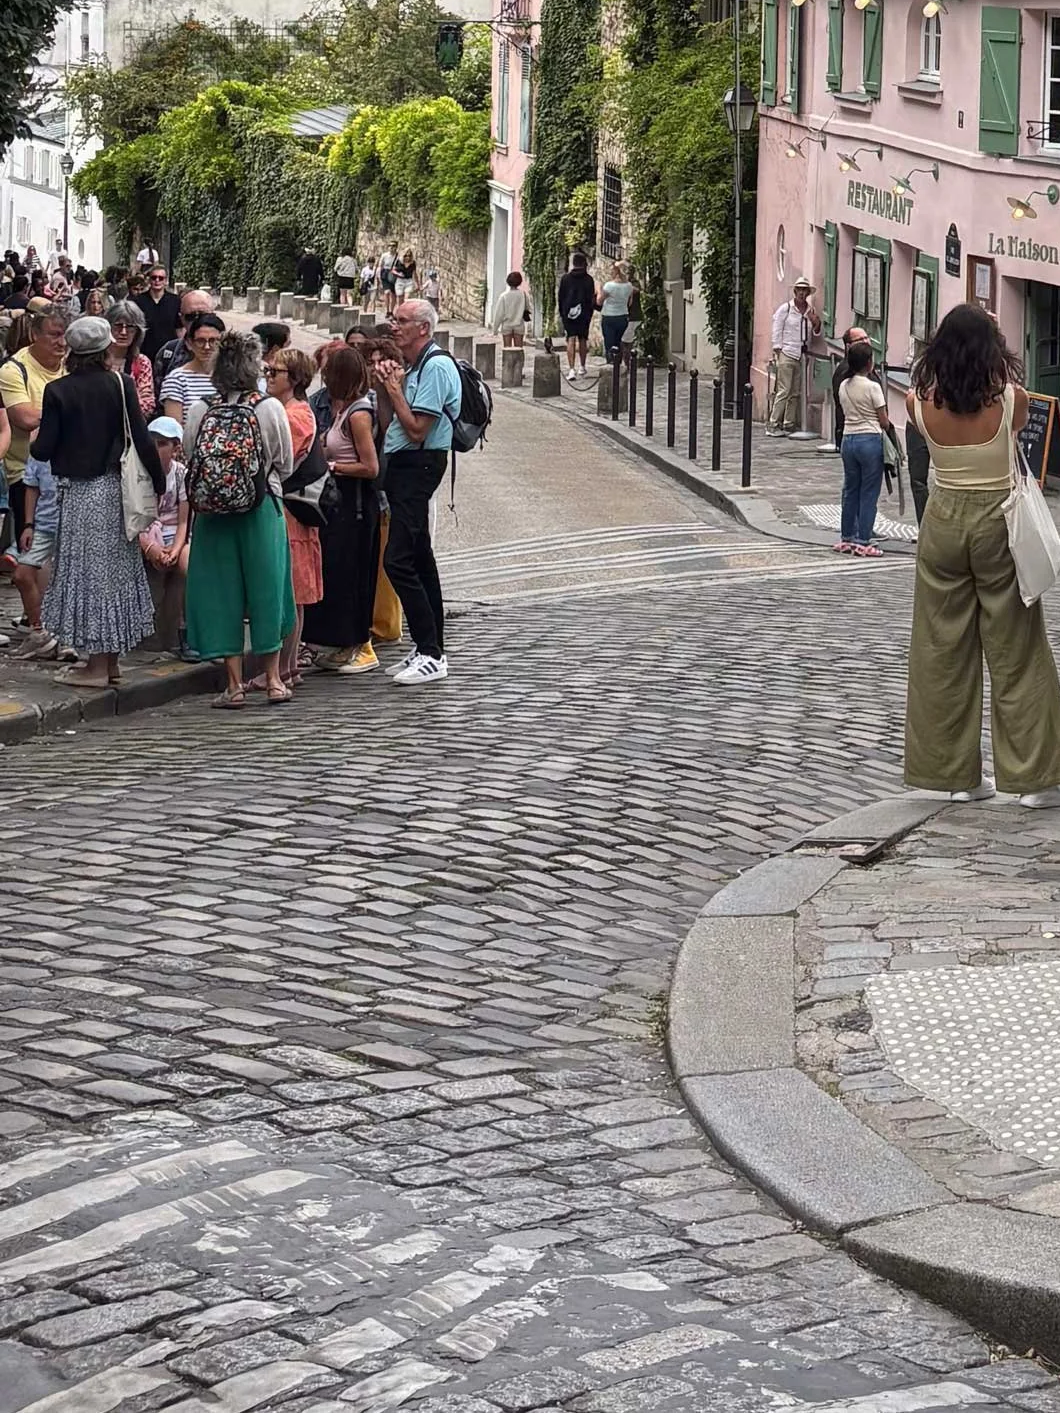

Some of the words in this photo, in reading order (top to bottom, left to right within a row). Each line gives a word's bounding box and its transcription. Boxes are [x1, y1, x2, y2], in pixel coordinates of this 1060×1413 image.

[847, 179, 914, 226] RESTAURANT
[988, 232, 1005, 255] La
[1007, 235, 1060, 265] Maison
